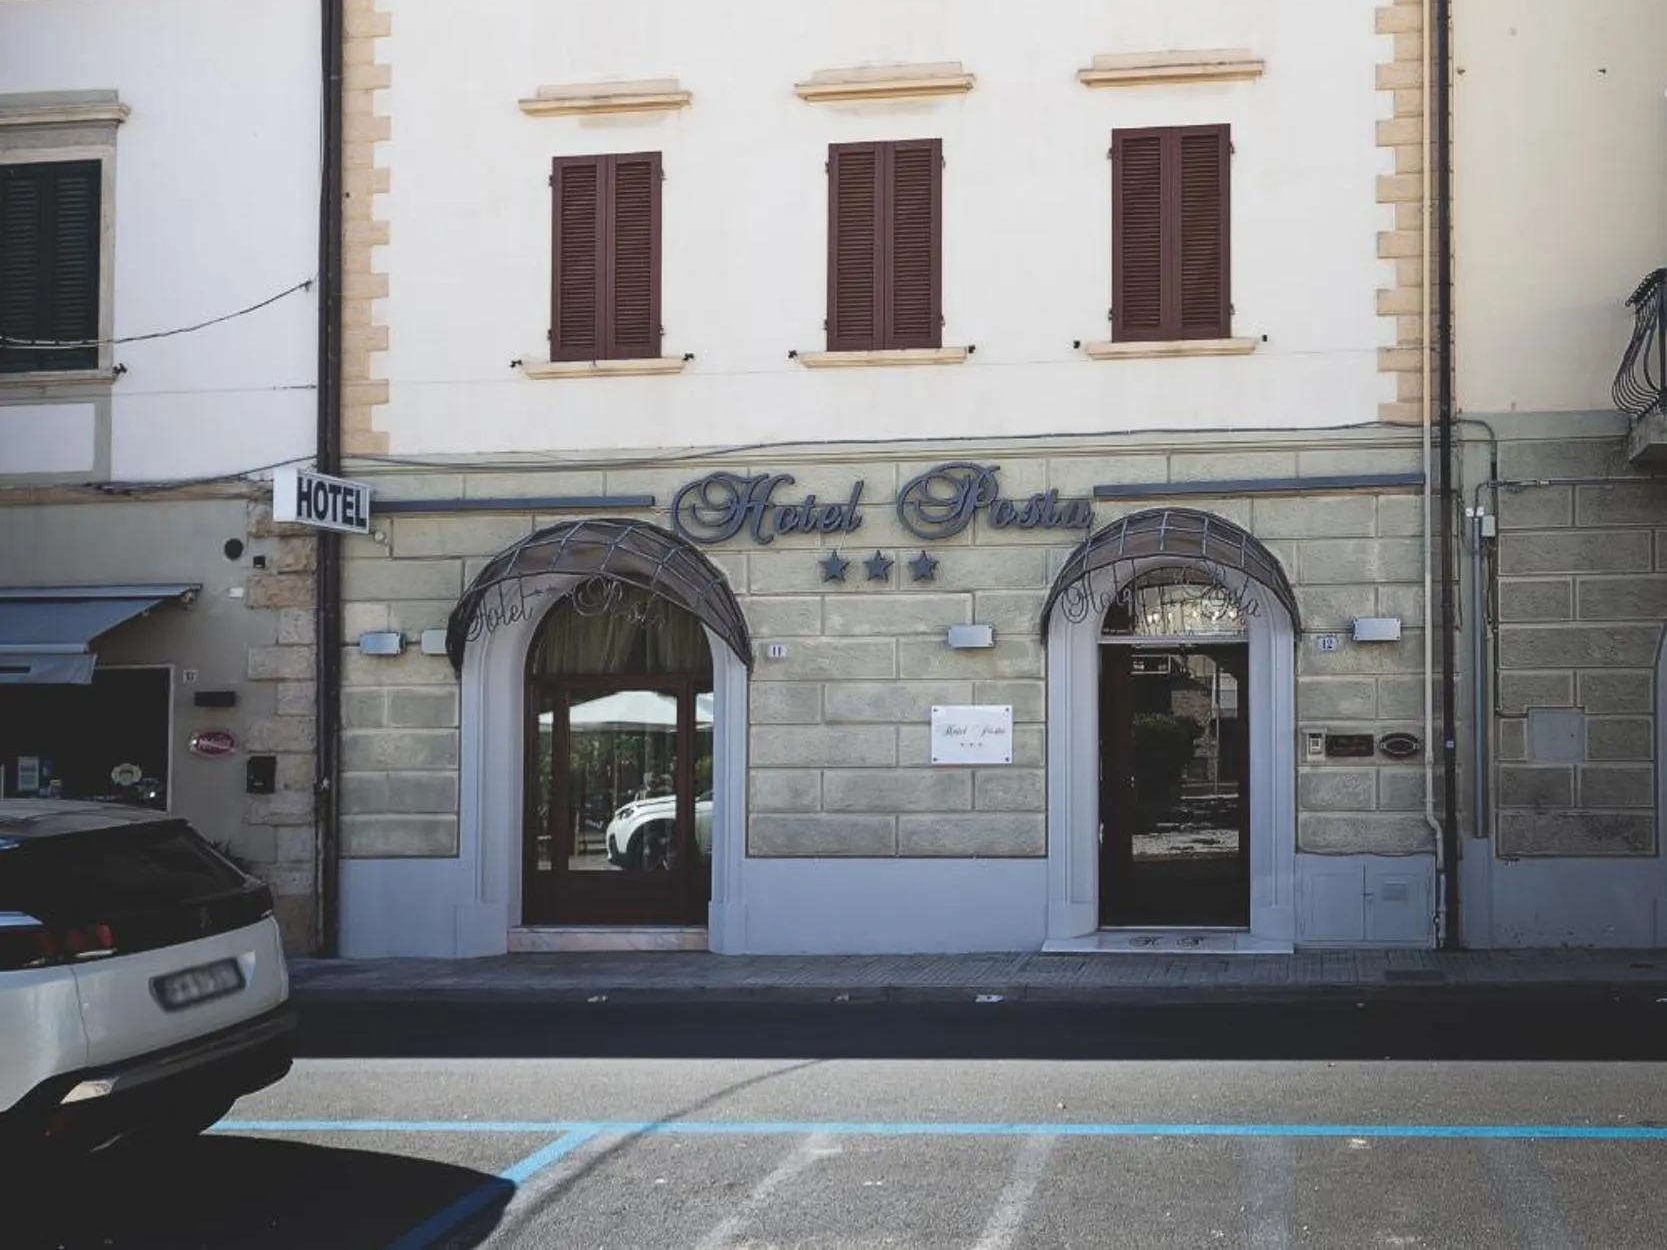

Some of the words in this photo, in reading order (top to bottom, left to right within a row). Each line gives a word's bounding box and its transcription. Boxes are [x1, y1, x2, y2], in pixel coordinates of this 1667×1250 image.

[297, 476, 367, 529] HOTEL
[672, 470, 865, 546] Hotel
[896, 461, 1095, 540] Posta
